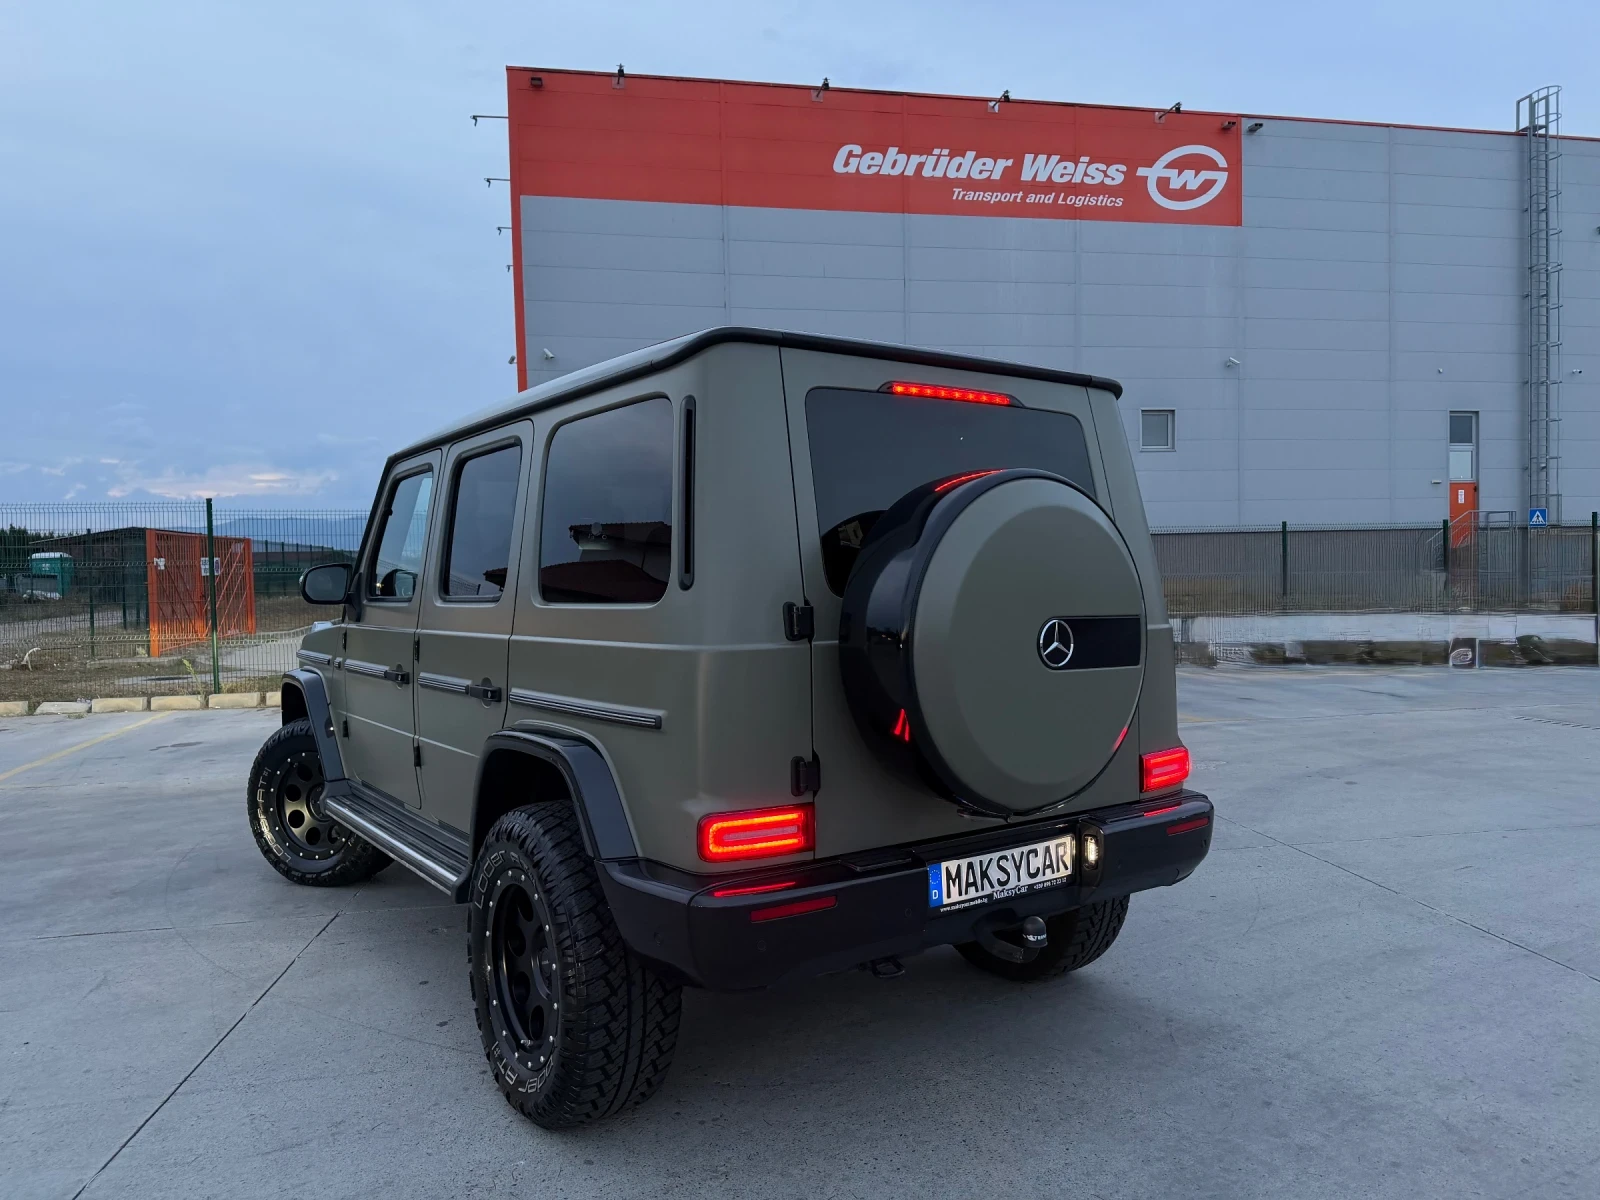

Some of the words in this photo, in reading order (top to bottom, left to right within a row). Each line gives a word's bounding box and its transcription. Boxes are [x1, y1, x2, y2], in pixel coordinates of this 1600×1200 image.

[832, 144, 1012, 181] Gebrüder
[1020, 153, 1127, 186] Weiss
[952, 188, 1023, 204] Transport
[1026, 191, 1055, 204] and
[1058, 192, 1124, 208] Logistics
[932, 889, 939, 900] D
[945, 842, 1069, 899] MAKSYCAR
[993, 885, 1029, 900] MaksyCar
